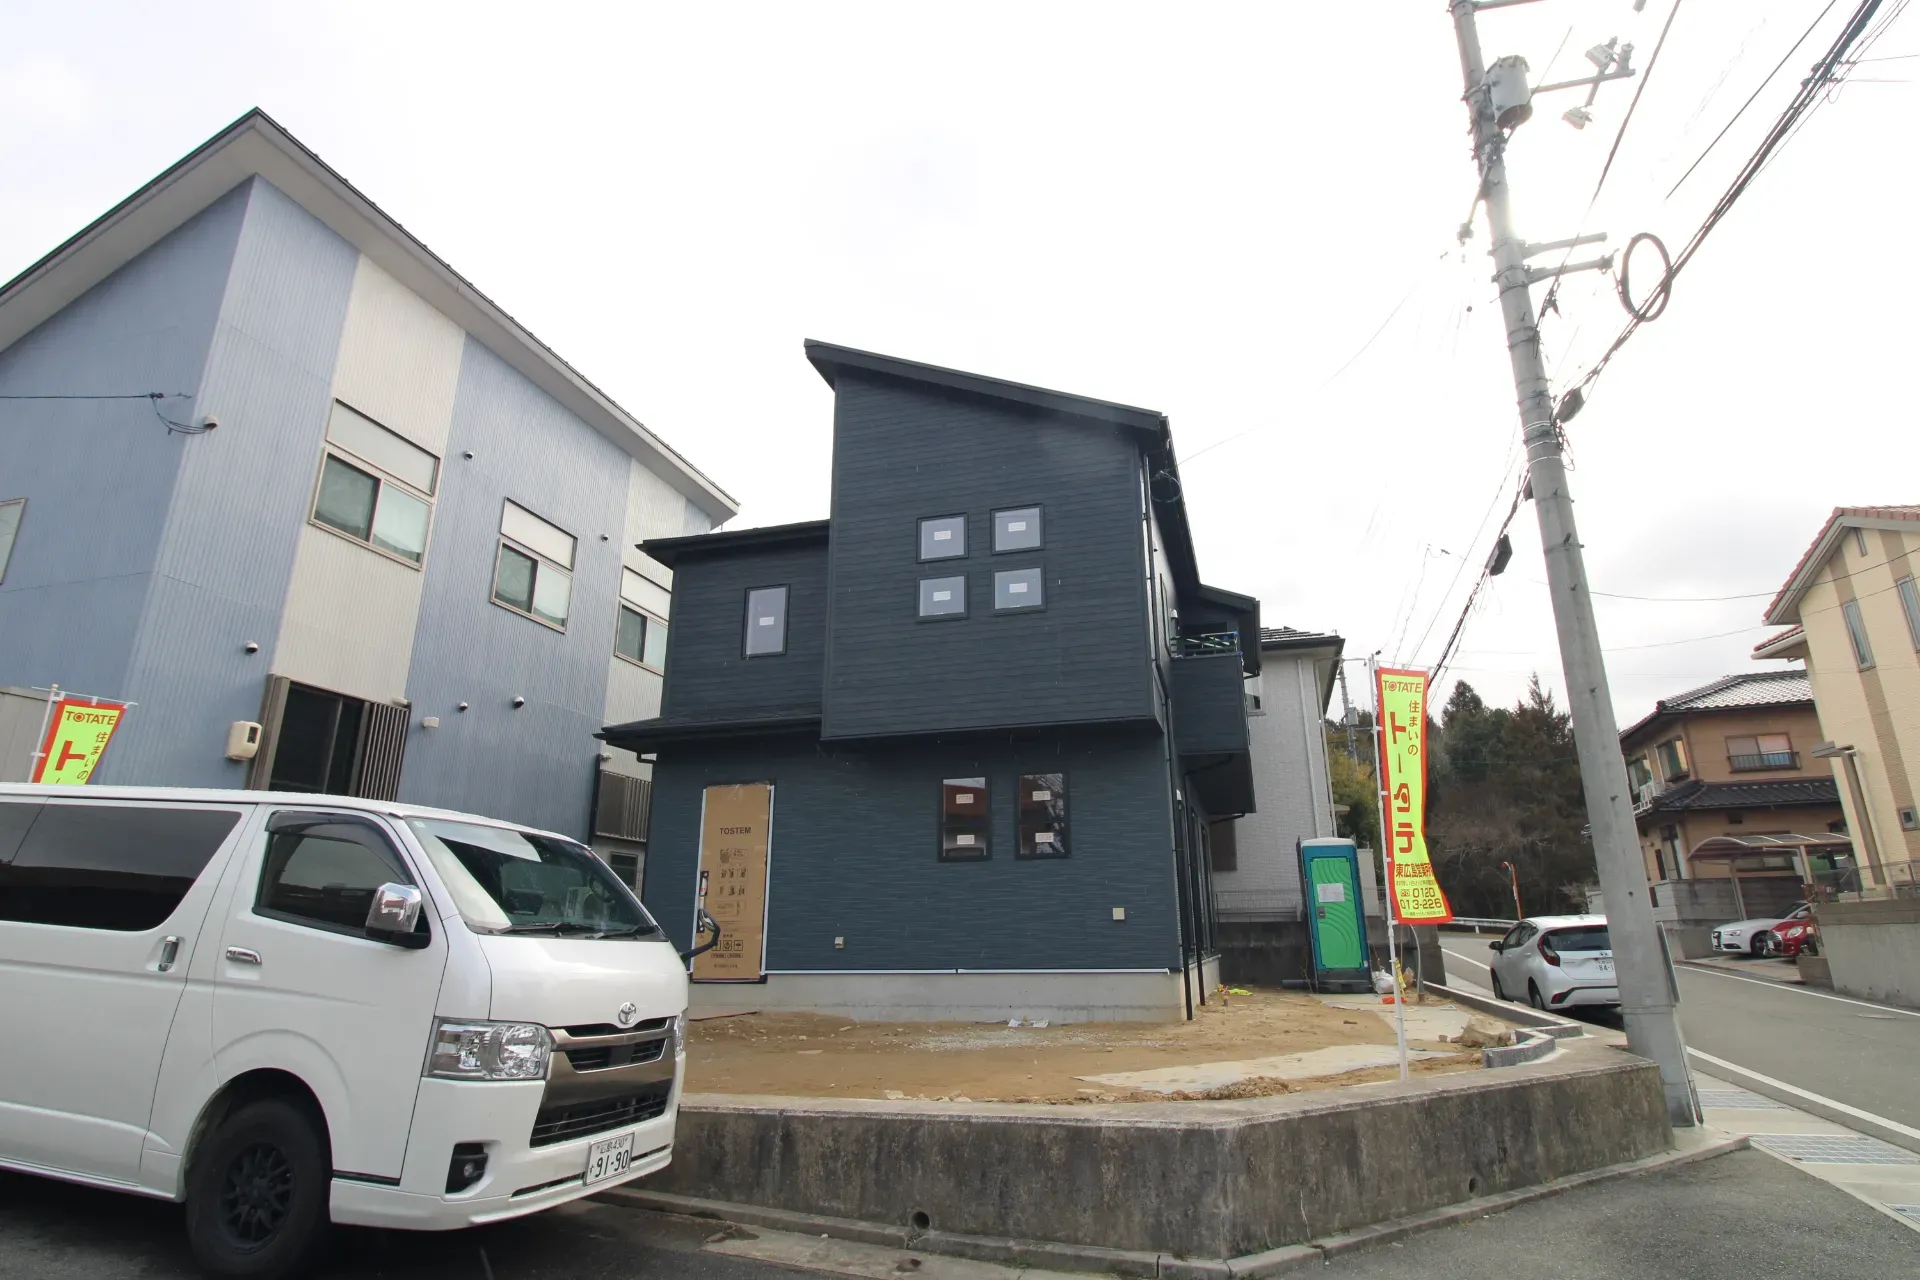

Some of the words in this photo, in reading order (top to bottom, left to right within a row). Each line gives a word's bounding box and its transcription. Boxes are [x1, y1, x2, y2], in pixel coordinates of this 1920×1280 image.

[1383, 679, 1422, 693] TOTATE
[66, 710, 116, 725] TOTATE
[1407, 700, 1420, 756] 住まいの
[55, 740, 86, 783] ト
[76, 731, 108, 780] 住まいの
[1390, 711, 1415, 853] トータテ
[719, 826, 752, 835] TOSTEM
[1412, 887, 1436, 898] 0120
[1399, 898, 1443, 910] 013-226
[595, 1150, 628, 1178] 91-90
